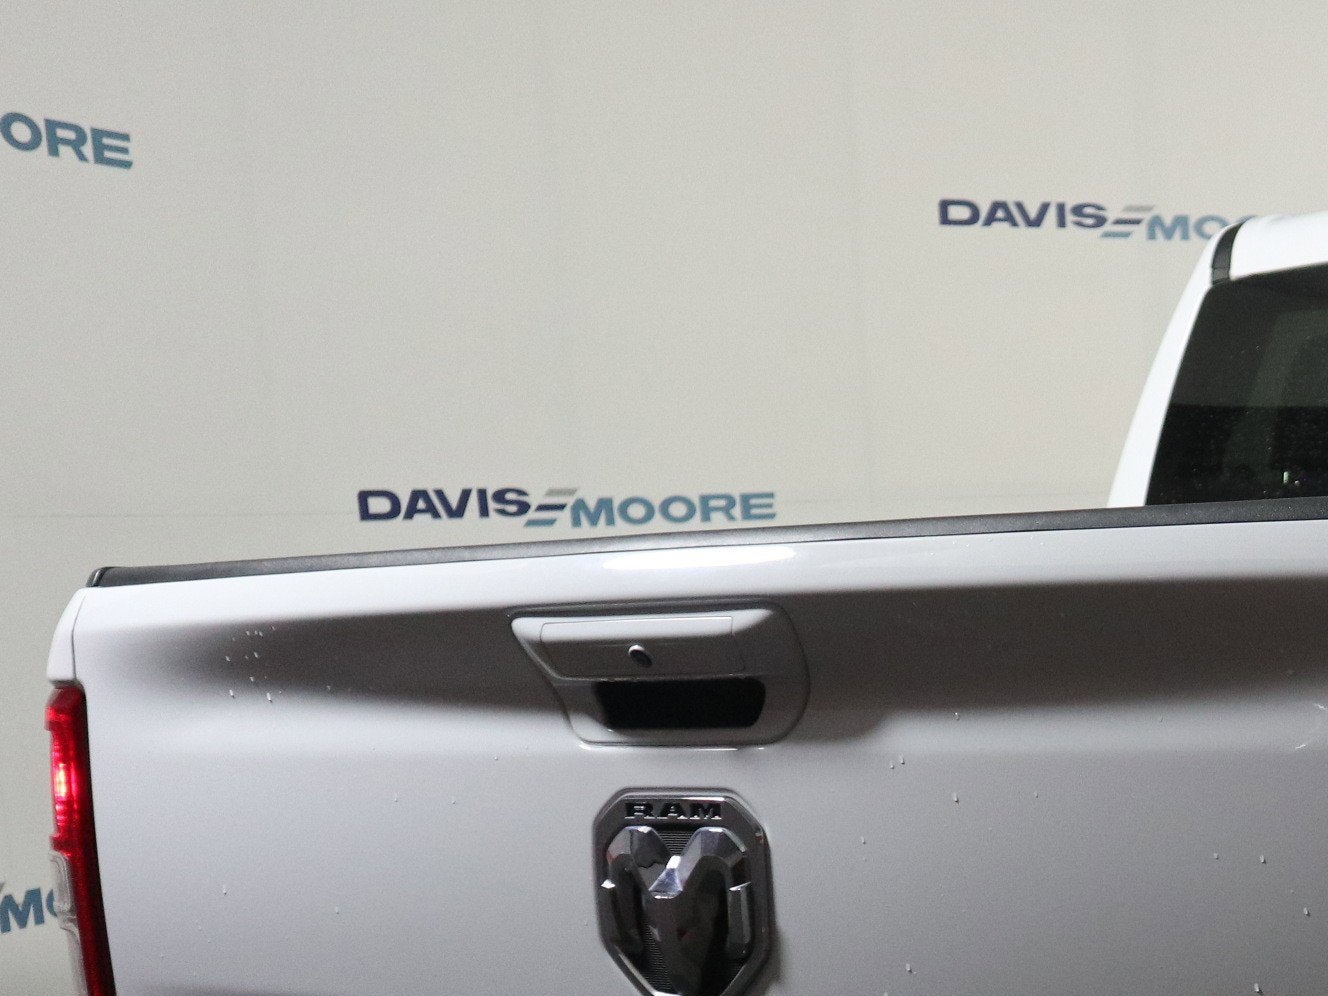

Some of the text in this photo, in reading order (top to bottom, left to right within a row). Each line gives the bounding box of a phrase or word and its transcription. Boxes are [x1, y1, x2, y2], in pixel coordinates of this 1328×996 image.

[0, 112, 133, 169] ORE
[938, 199, 1256, 240] DAVIS MO
[357, 487, 777, 527] DAVIS MOORE
[625, 801, 722, 820] RAM
